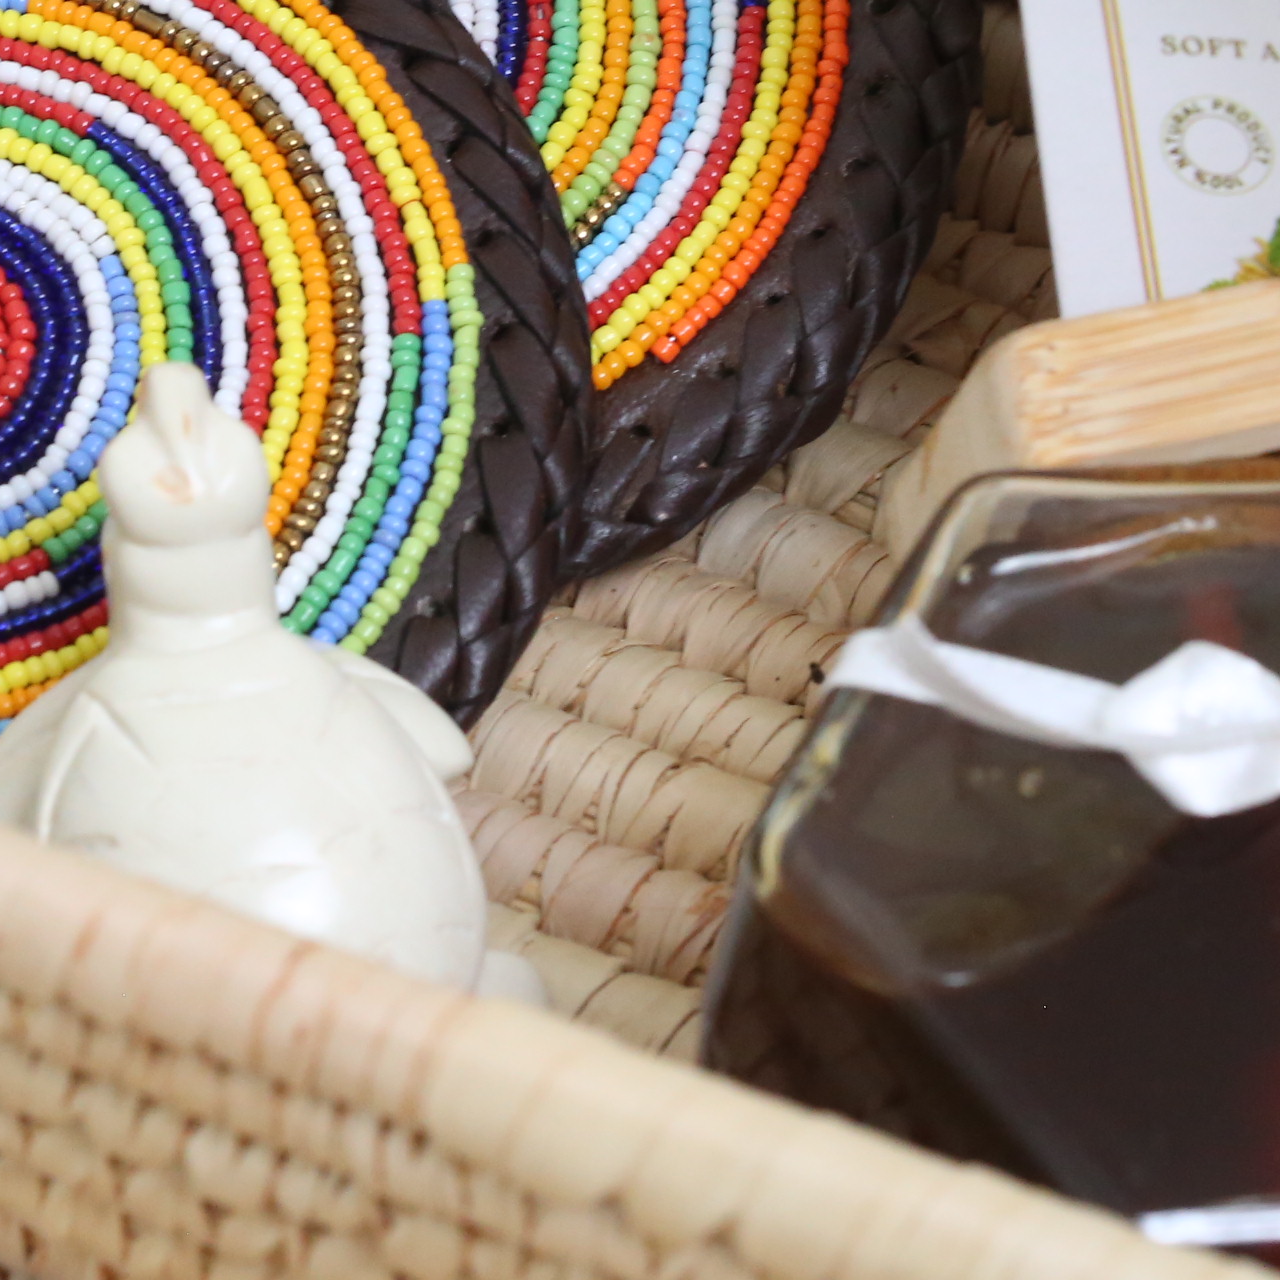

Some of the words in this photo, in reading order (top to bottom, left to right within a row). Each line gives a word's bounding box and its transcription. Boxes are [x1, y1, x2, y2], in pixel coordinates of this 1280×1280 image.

[1160, 34, 1247, 59] SOFT
[1164, 102, 1205, 169] NATURAL
[1211, 97, 1272, 165] PRODUCT
